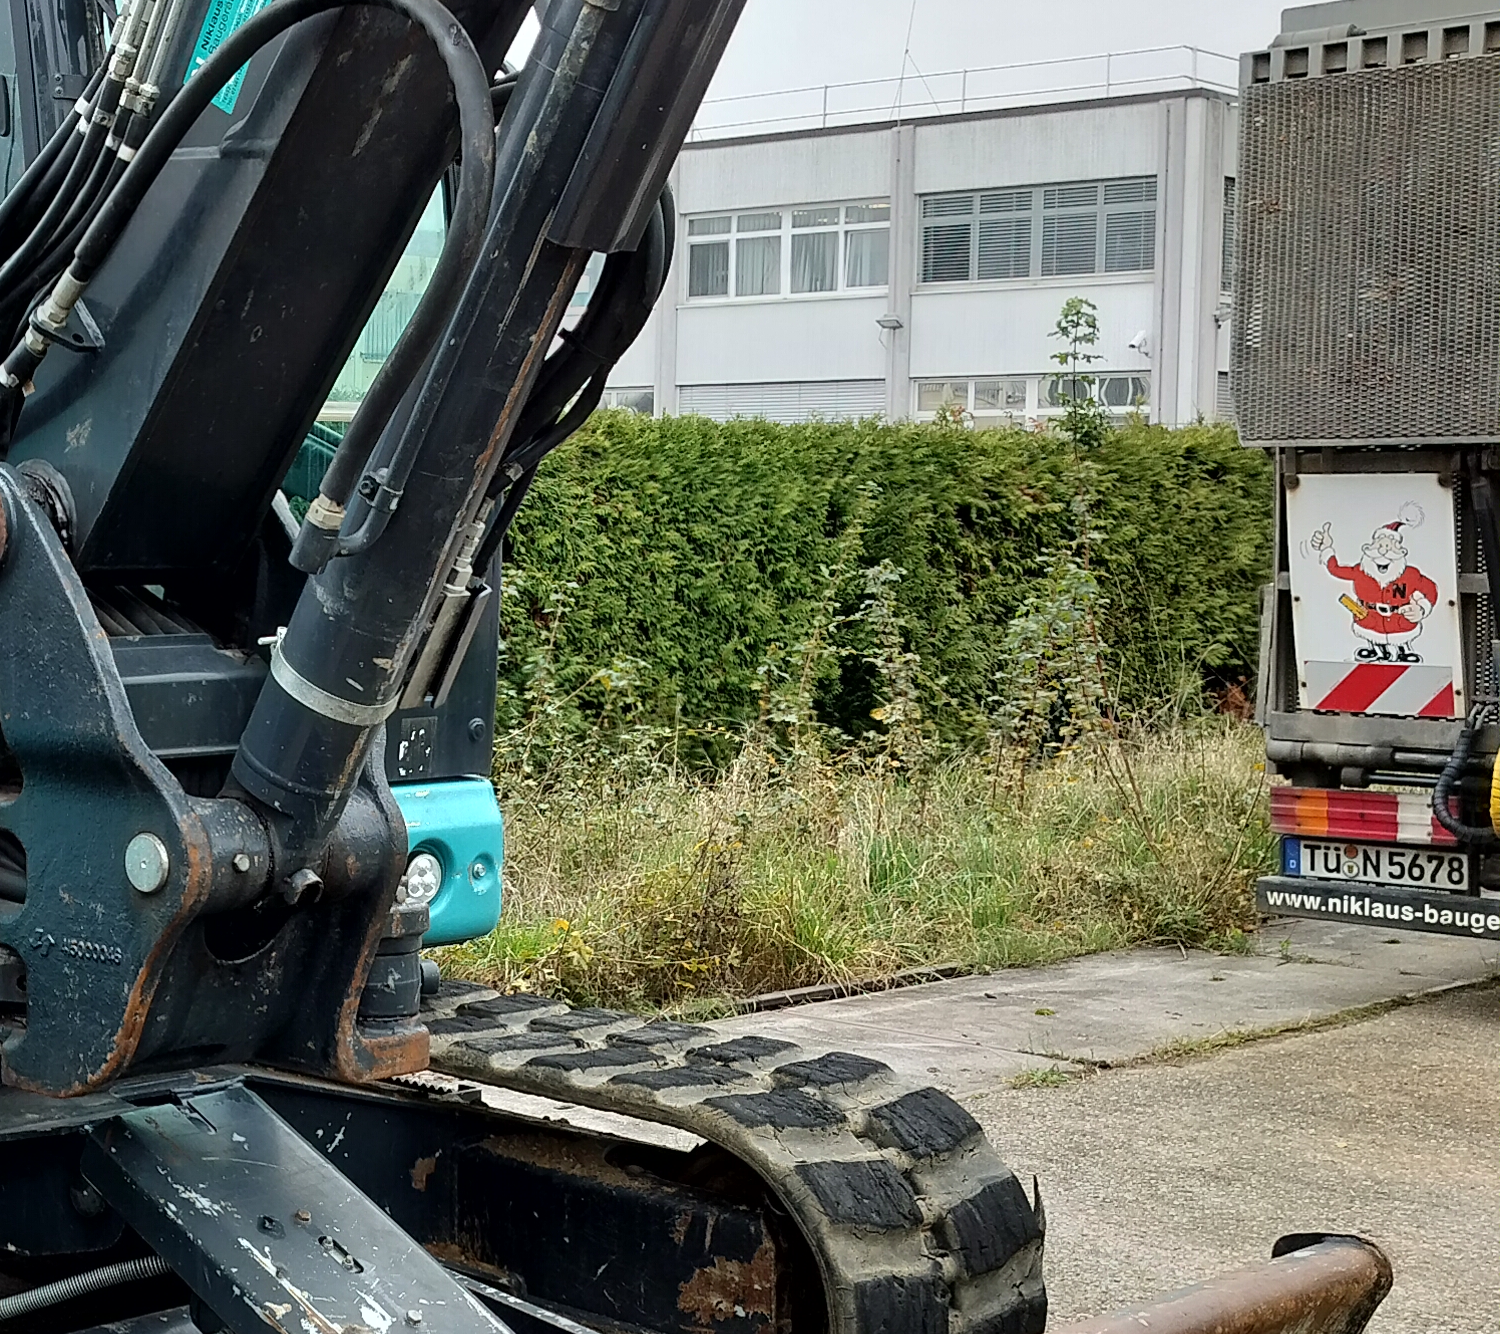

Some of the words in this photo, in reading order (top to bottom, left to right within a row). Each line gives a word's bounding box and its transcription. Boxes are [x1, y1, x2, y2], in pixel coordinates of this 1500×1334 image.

[1392, 582, 1407, 599] N
[1289, 859, 1297, 869] D
[1303, 843, 1341, 874] TÜ
[1362, 848, 1381, 878] N
[1388, 851, 1465, 886] 5678
[1266, 889, 1500, 935] www.niklaus-bauge
